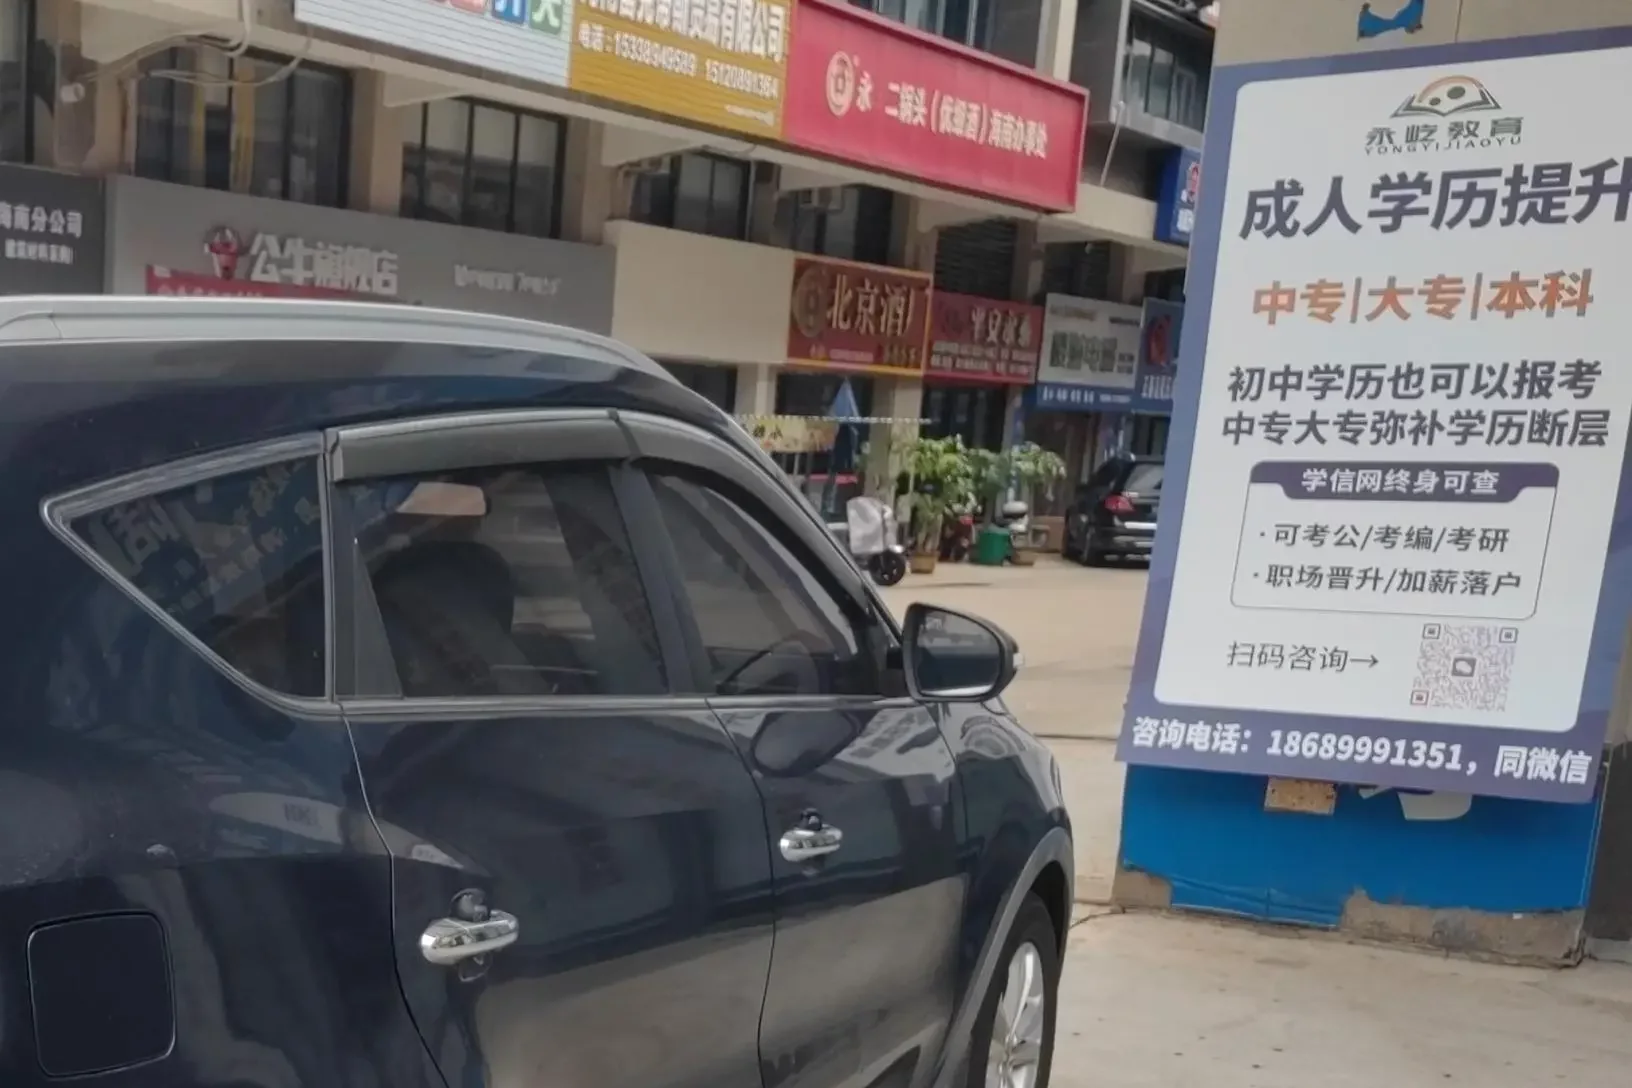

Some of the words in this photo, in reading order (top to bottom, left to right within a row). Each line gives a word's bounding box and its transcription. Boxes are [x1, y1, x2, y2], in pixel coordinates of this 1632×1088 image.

[1364, 136, 1522, 156] YONGYIJIAOYU
[1239, 157, 1632, 239] 成人学历提升
[1227, 359, 1602, 402] 初中学历也可以报考
[1222, 409, 1610, 447] 中专大专弥补学历断层
[1301, 468, 1500, 495] 学信网终身可查
